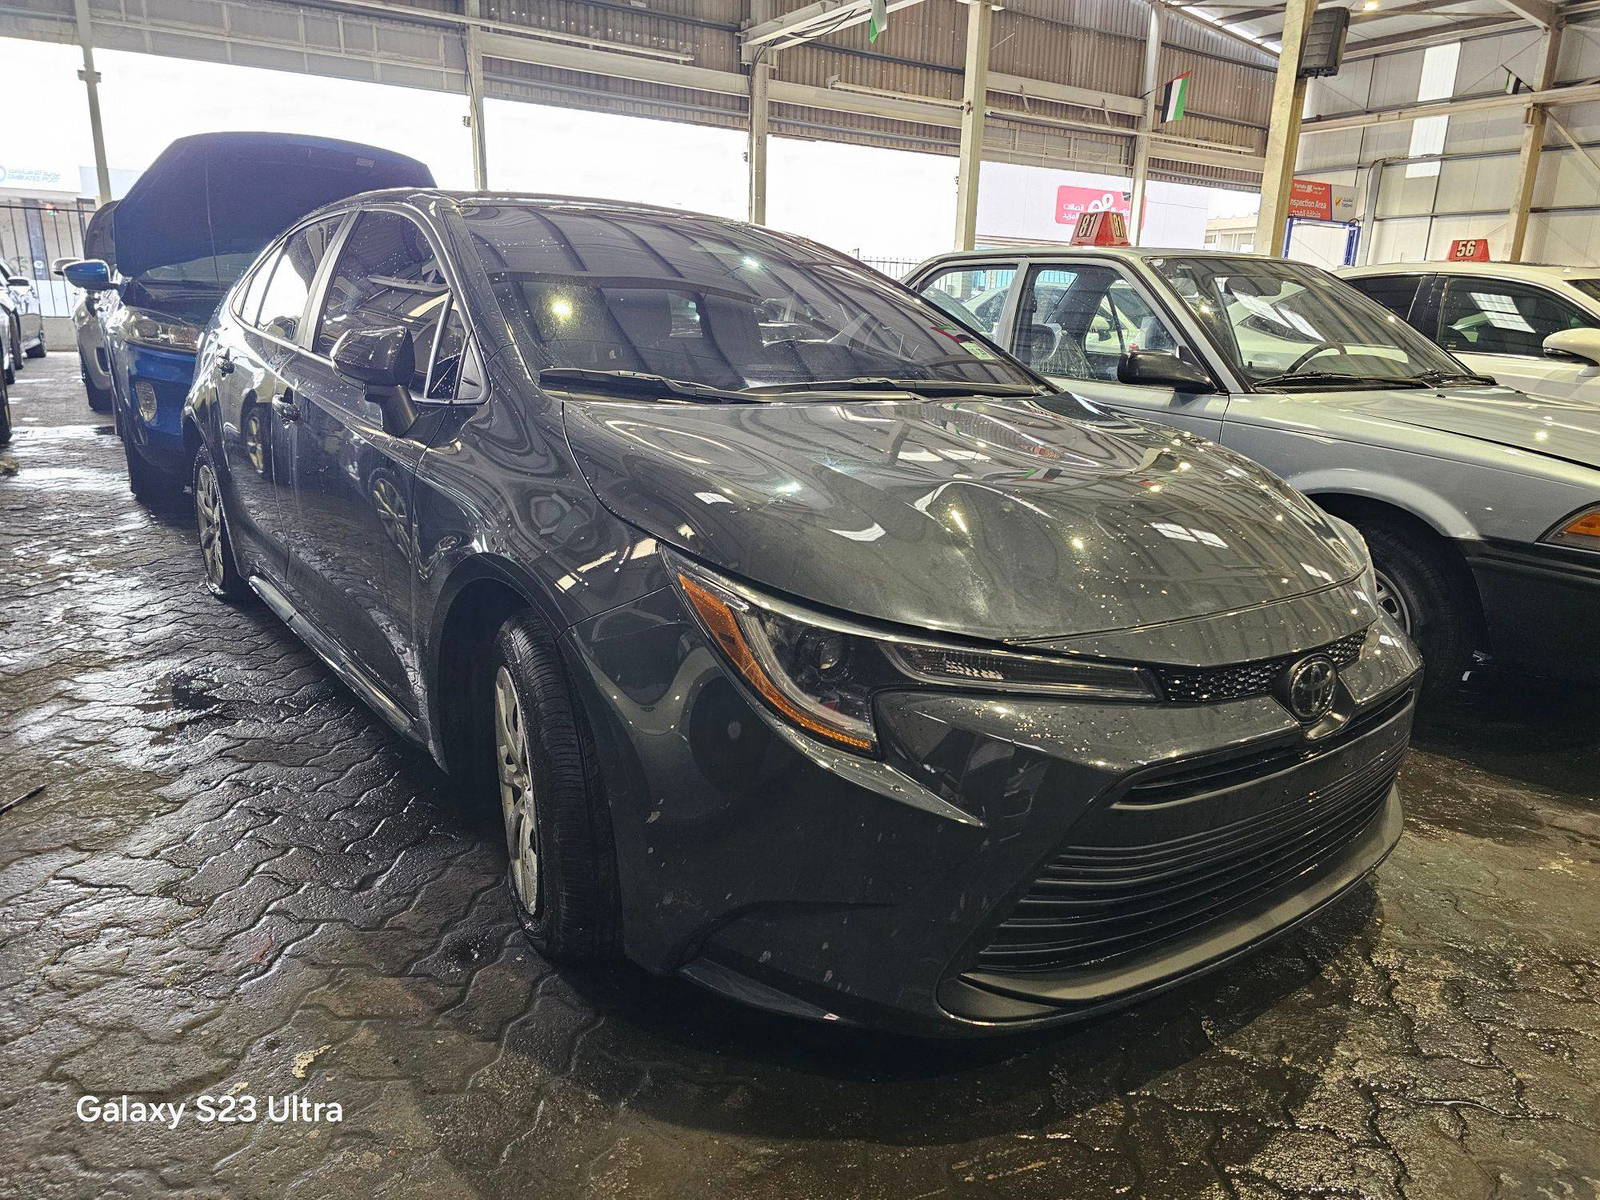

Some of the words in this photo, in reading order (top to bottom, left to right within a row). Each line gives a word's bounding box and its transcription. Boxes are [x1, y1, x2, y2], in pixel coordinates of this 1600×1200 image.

[1289, 199, 1315, 208] nspection
[1078, 213, 1097, 237] 81
[1112, 213, 1124, 237] 81
[1456, 240, 1476, 257] 56
